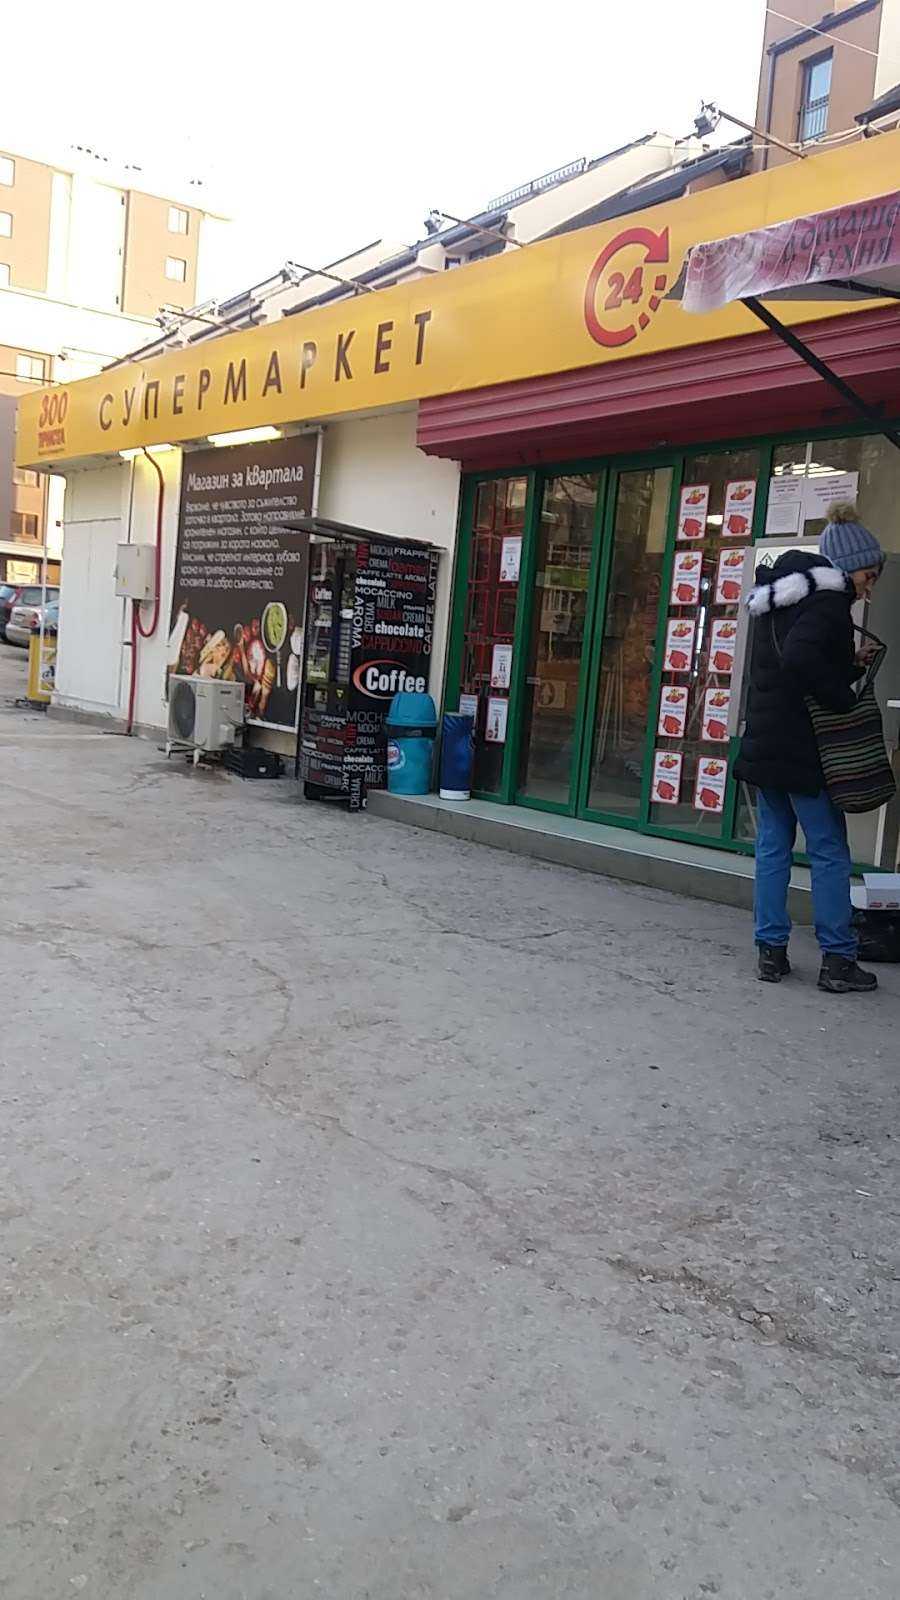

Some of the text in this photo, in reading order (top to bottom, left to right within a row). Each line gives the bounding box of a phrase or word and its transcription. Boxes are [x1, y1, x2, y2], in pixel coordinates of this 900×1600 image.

[604, 266, 643, 312] 24
[99, 310, 432, 431] СУПЕРМАРКЕТ
[39, 391, 68, 429] 300
[186, 464, 304, 492] Магазин за квартала
[356, 569, 380, 577] CAFFE
[354, 586, 413, 600] MOCACCINO
[422, 551, 440, 655] CAFFE LATTE
[351, 595, 365, 649] AROMA
[374, 620, 424, 638] chocolate
[365, 666, 426, 693] Coffee
[346, 711, 384, 723] MOCH
[342, 764, 386, 772] MOCACC
